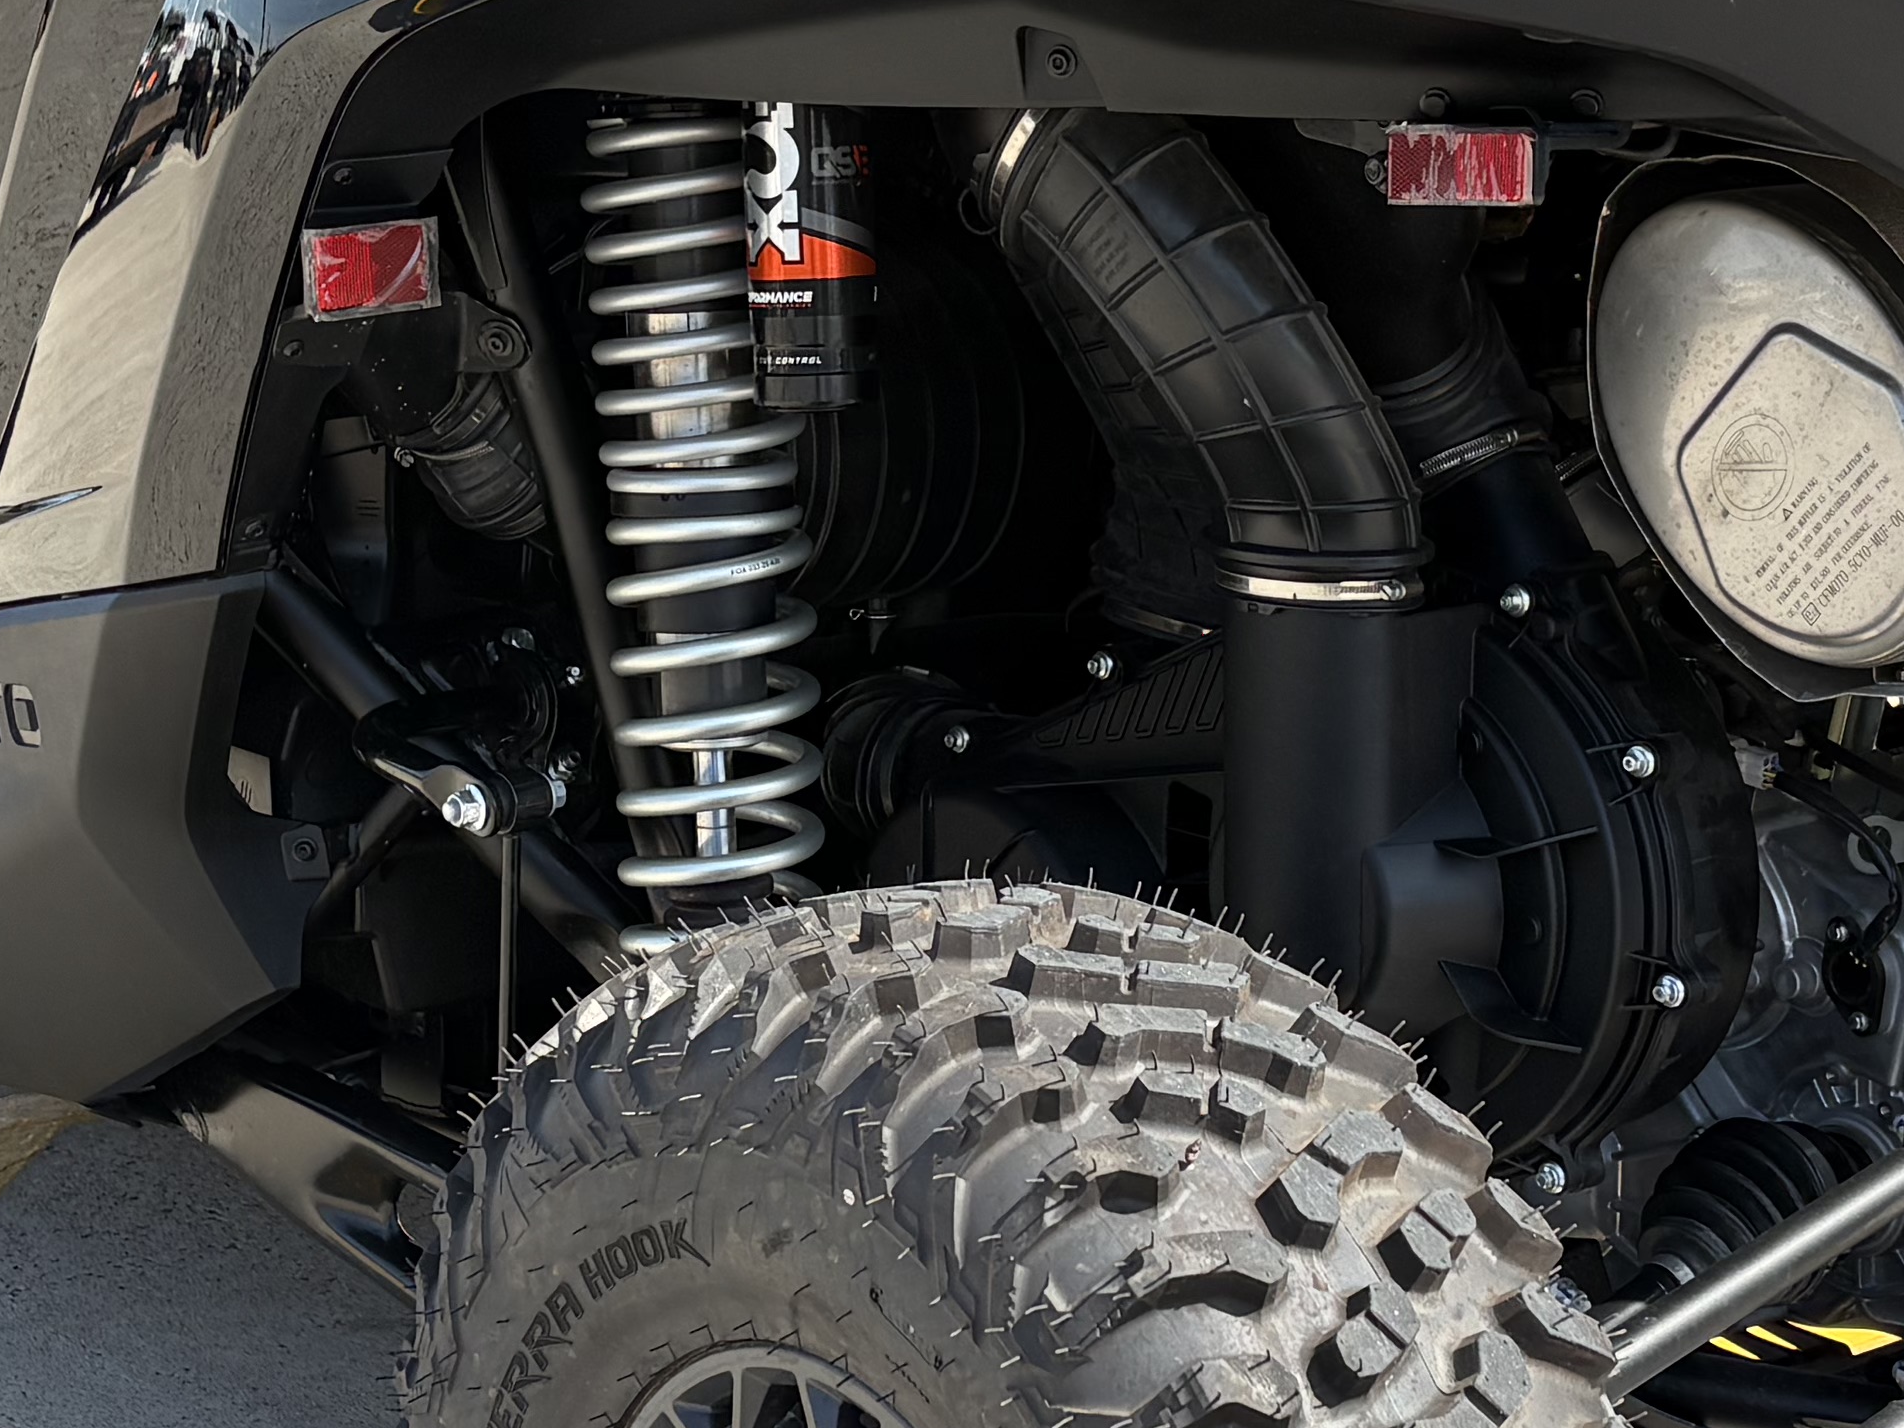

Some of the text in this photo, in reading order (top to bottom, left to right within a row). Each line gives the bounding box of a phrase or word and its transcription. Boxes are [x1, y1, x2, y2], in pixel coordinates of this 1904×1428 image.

[742, 102, 800, 263] OX
[1817, 569, 1849, 608] CFMOTO
[578, 1217, 711, 1301] HOOK
